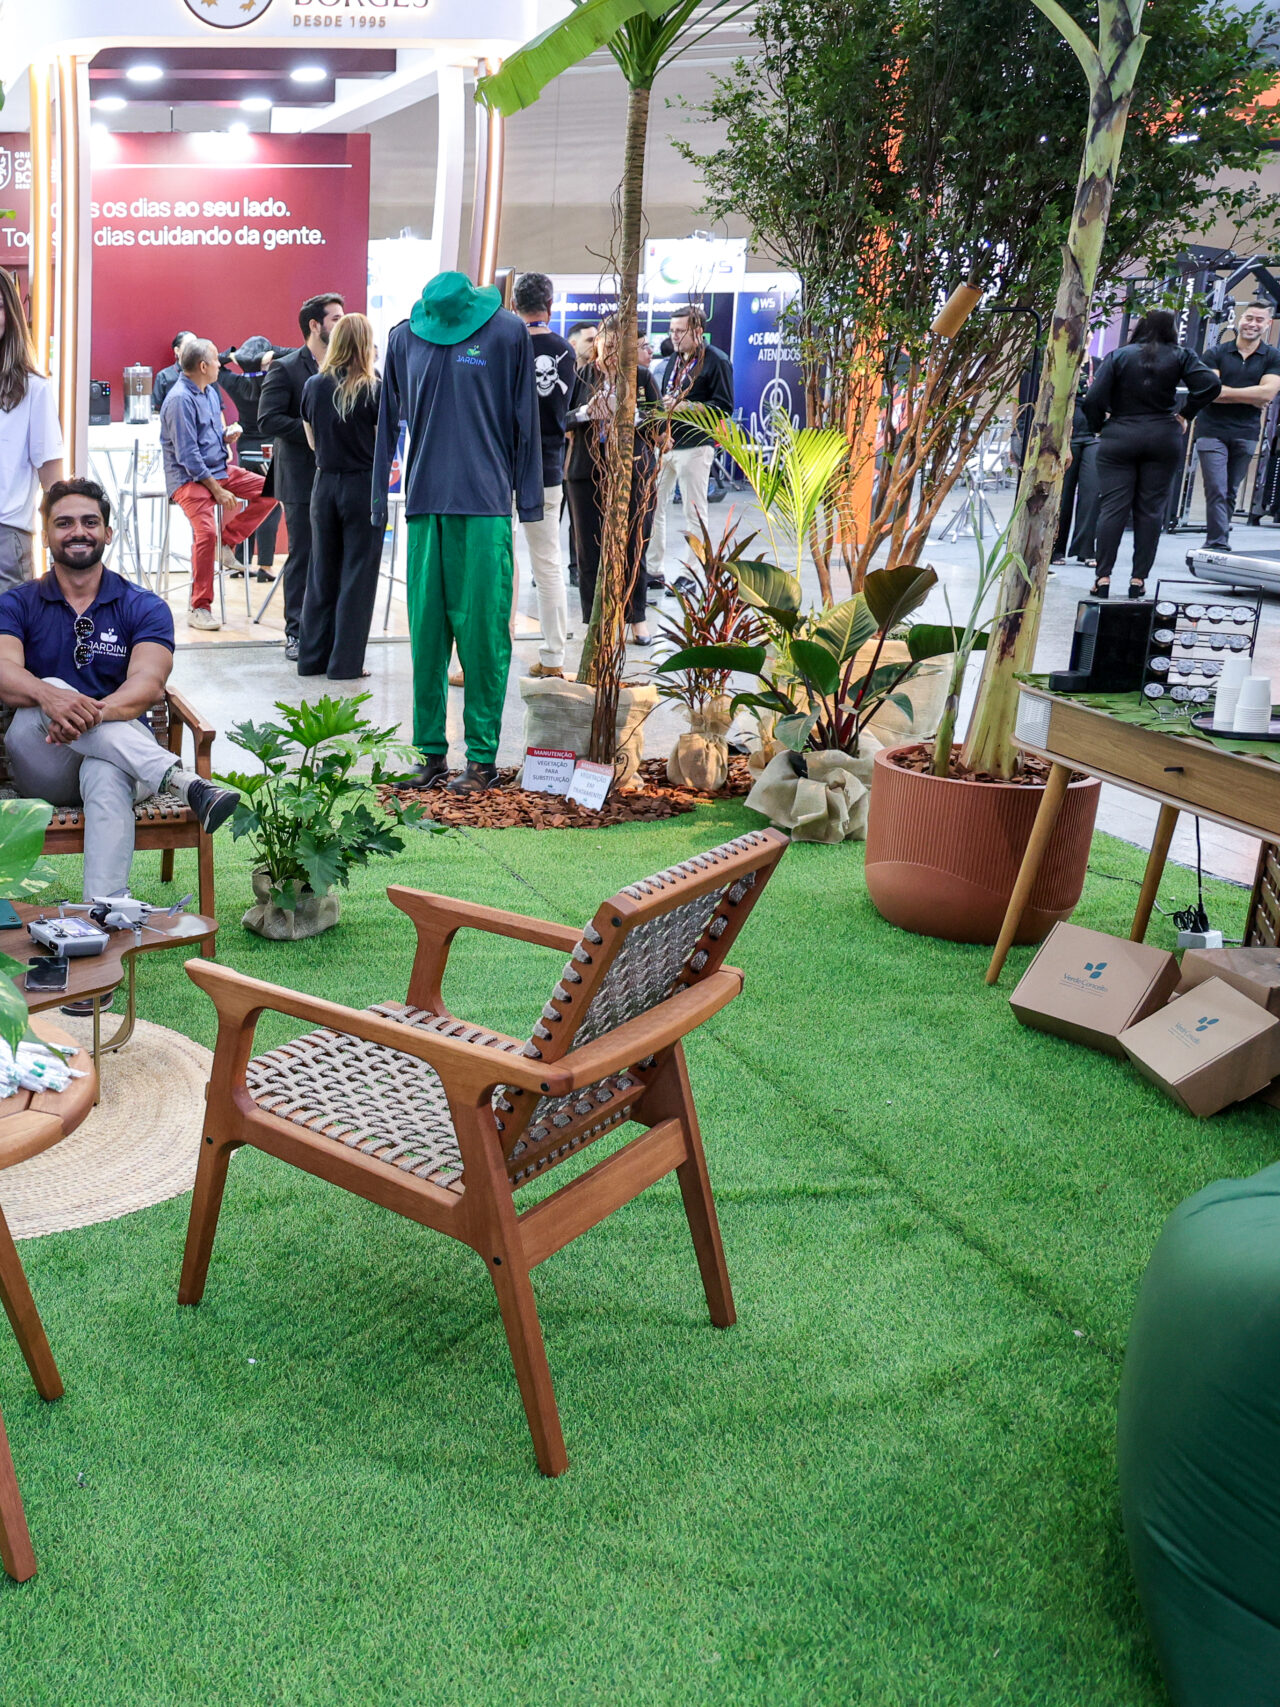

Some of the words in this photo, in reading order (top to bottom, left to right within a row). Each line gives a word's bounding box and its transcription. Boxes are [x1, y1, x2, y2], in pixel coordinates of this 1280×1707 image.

[293, 14, 343, 27] DESDE
[350, 15, 387, 28] 1995
[102, 200, 128, 218] os
[129, 197, 171, 218] dias
[173, 200, 200, 217] ao
[202, 200, 240, 217] seu
[243, 197, 291, 217] lado.
[93, 226, 136, 247] dias
[137, 225, 232, 246] cuidando
[234, 225, 260, 246] da
[262, 226, 327, 251] gente.
[457, 355, 487, 367] JARDINI
[90, 641, 127, 654] JARDINI
[533, 749, 573, 759] MANUTENÇÃO
[537, 760, 568, 768] VEGETAÇÃO
[532, 774, 570, 783] SUBSTITUIÇÃO
